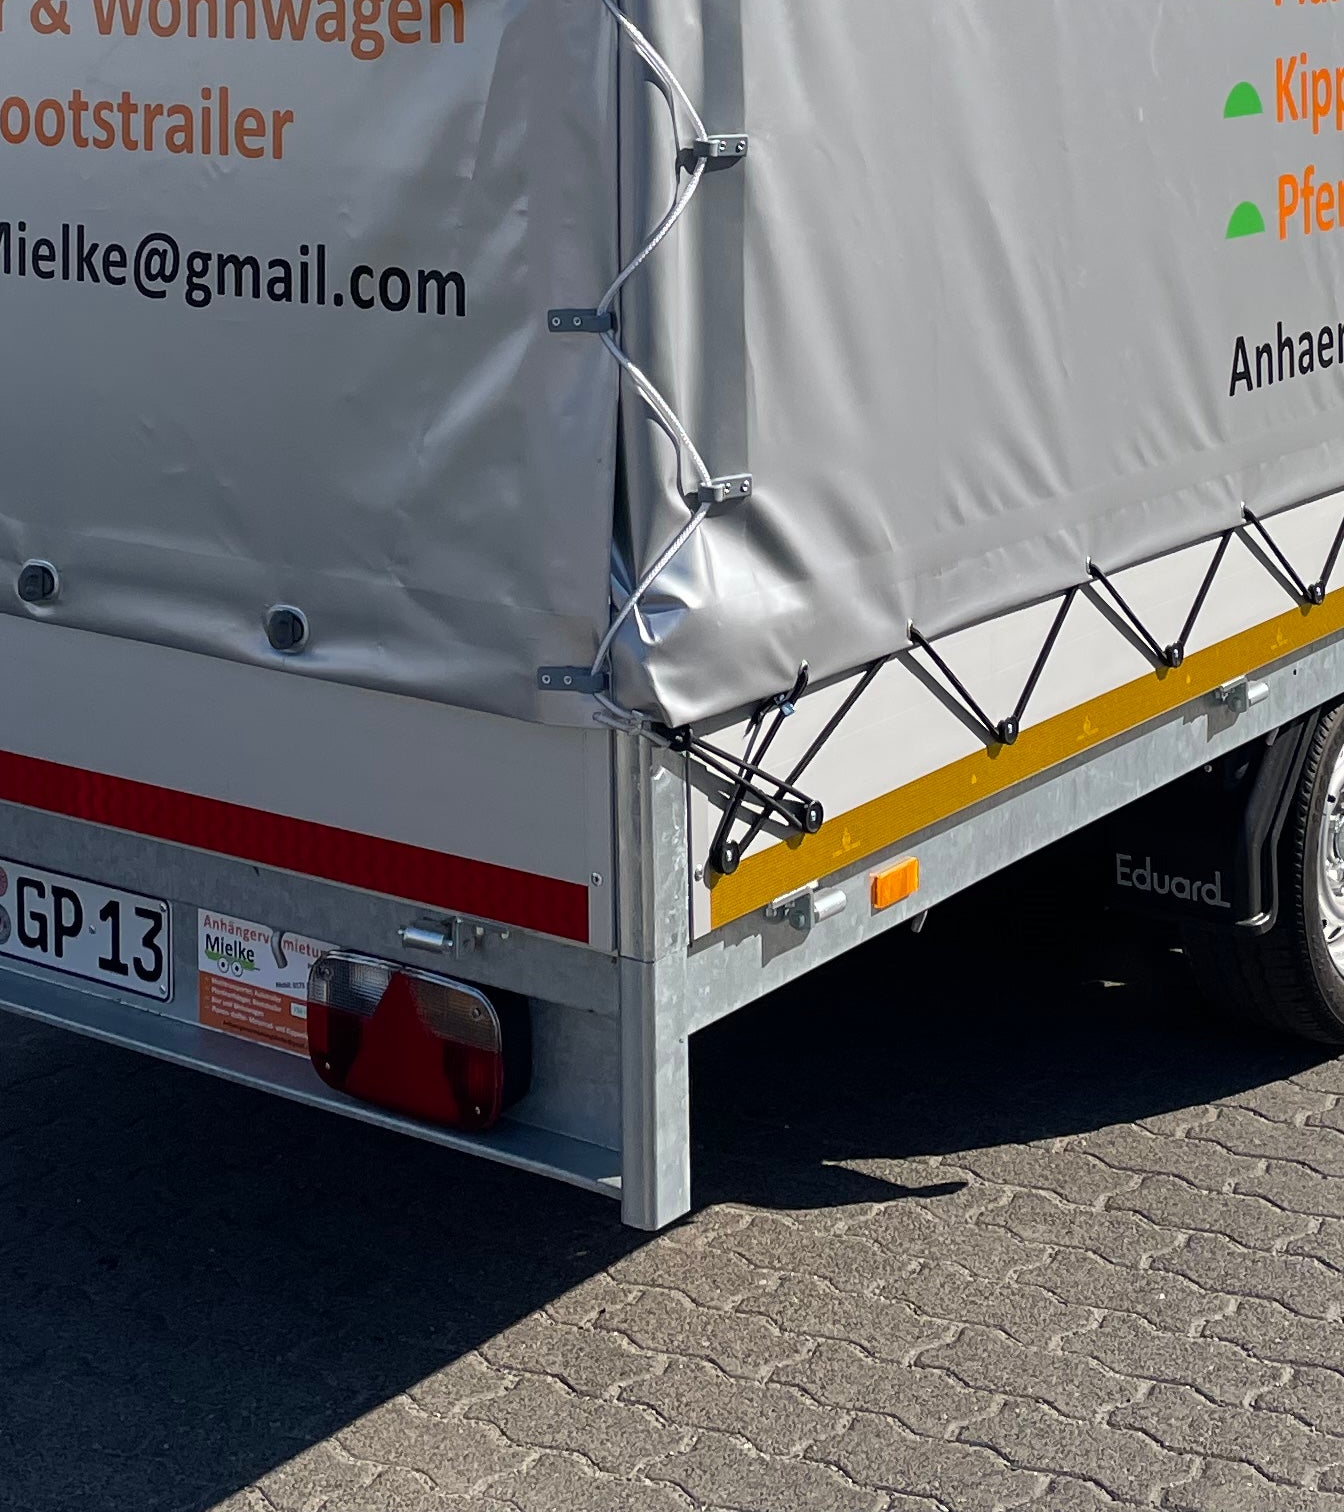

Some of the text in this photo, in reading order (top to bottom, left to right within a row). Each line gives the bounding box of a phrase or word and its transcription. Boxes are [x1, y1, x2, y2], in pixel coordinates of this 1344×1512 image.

[1116, 852, 1232, 908] Eduard
[15, 875, 84, 959] GP
[98, 899, 164, 982] 13
[205, 933, 256, 963] Mielke
